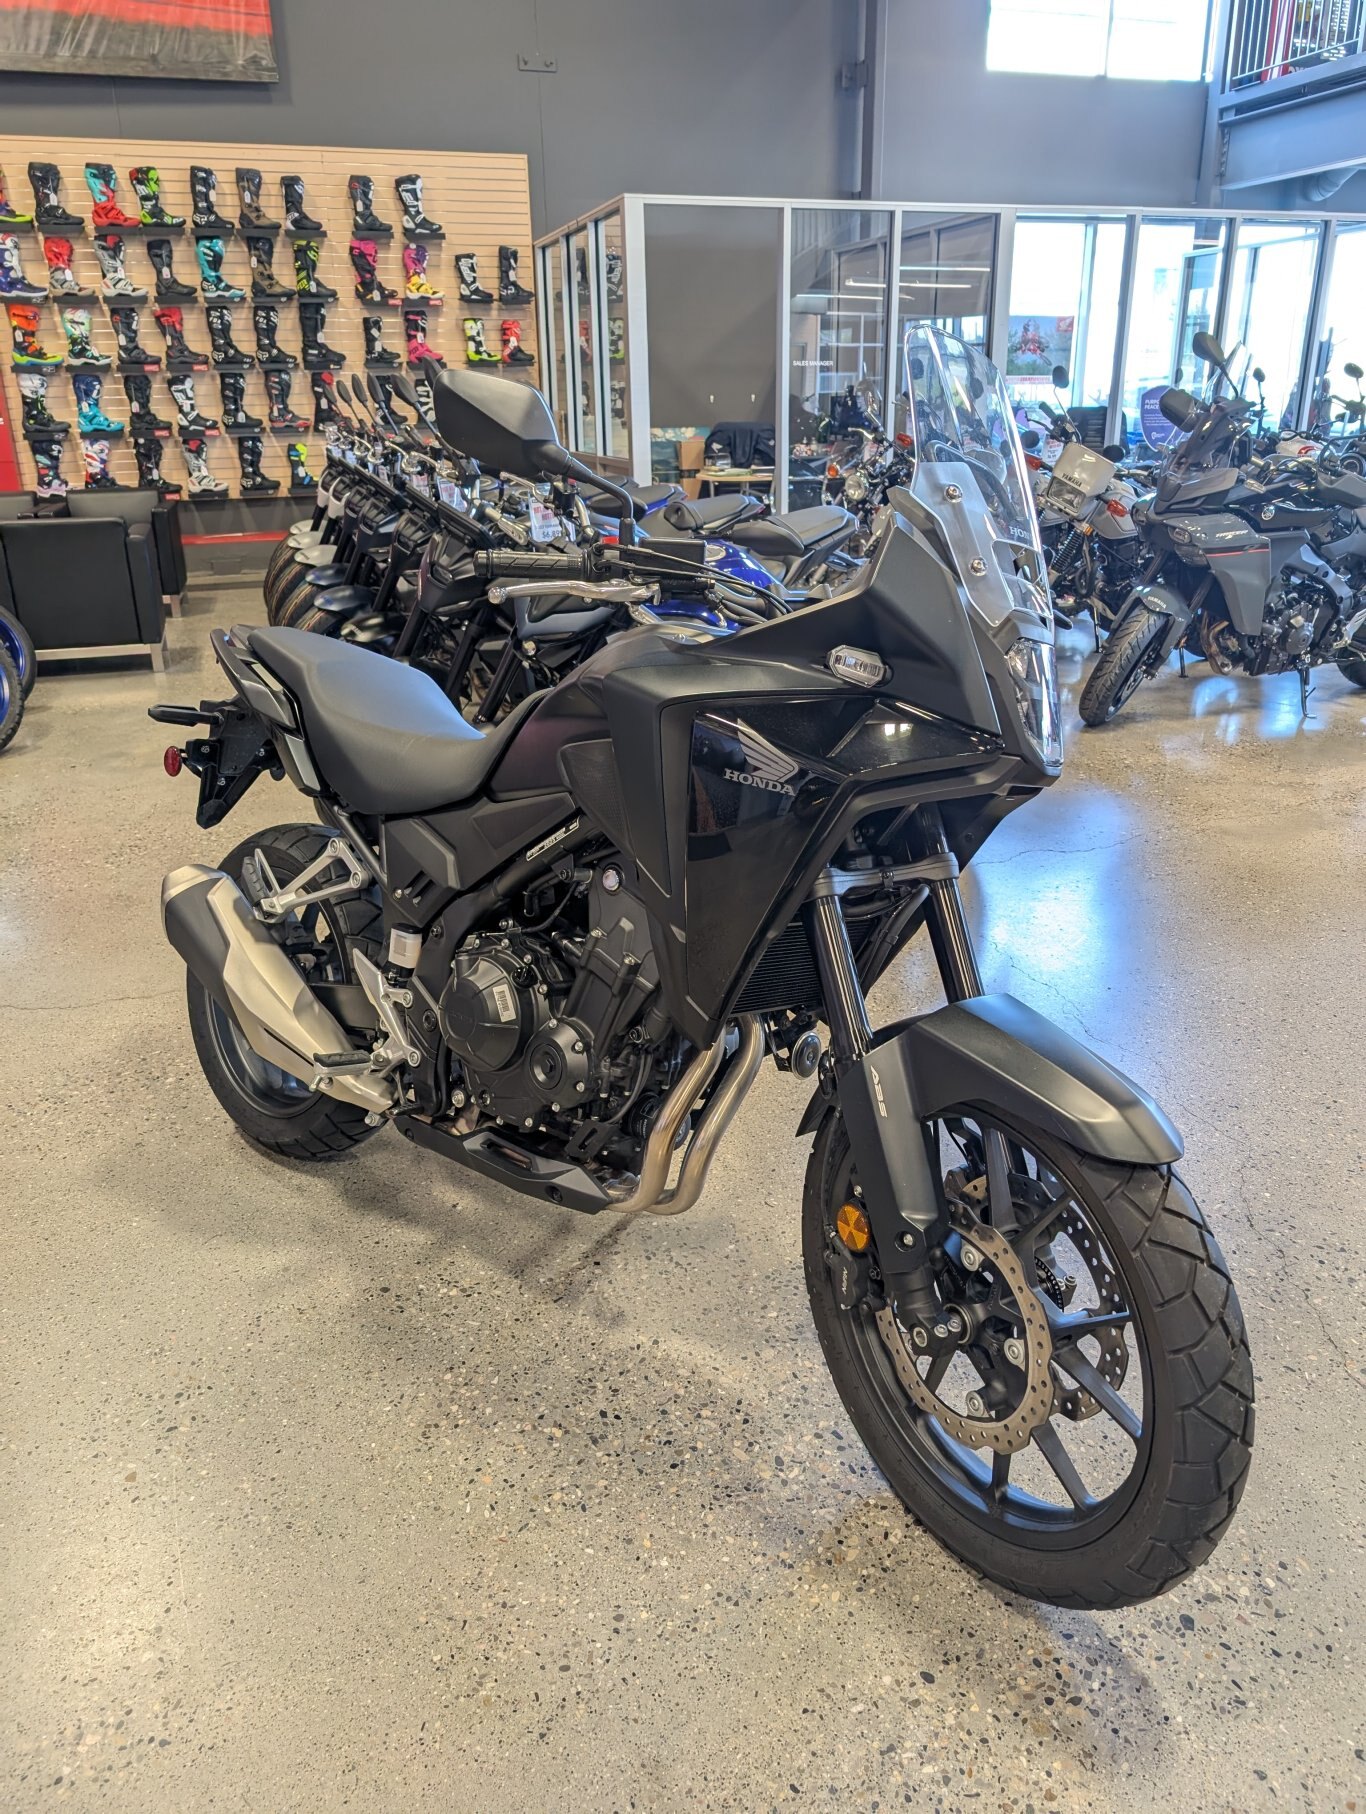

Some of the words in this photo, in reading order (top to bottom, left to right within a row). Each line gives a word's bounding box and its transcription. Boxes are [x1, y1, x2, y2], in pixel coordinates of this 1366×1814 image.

[1061, 472, 1083, 488] YAMAHA
[1147, 596, 1167, 609] YAMAHA
[723, 767, 796, 796] HONDA
[870, 1065, 888, 1118] ABS
